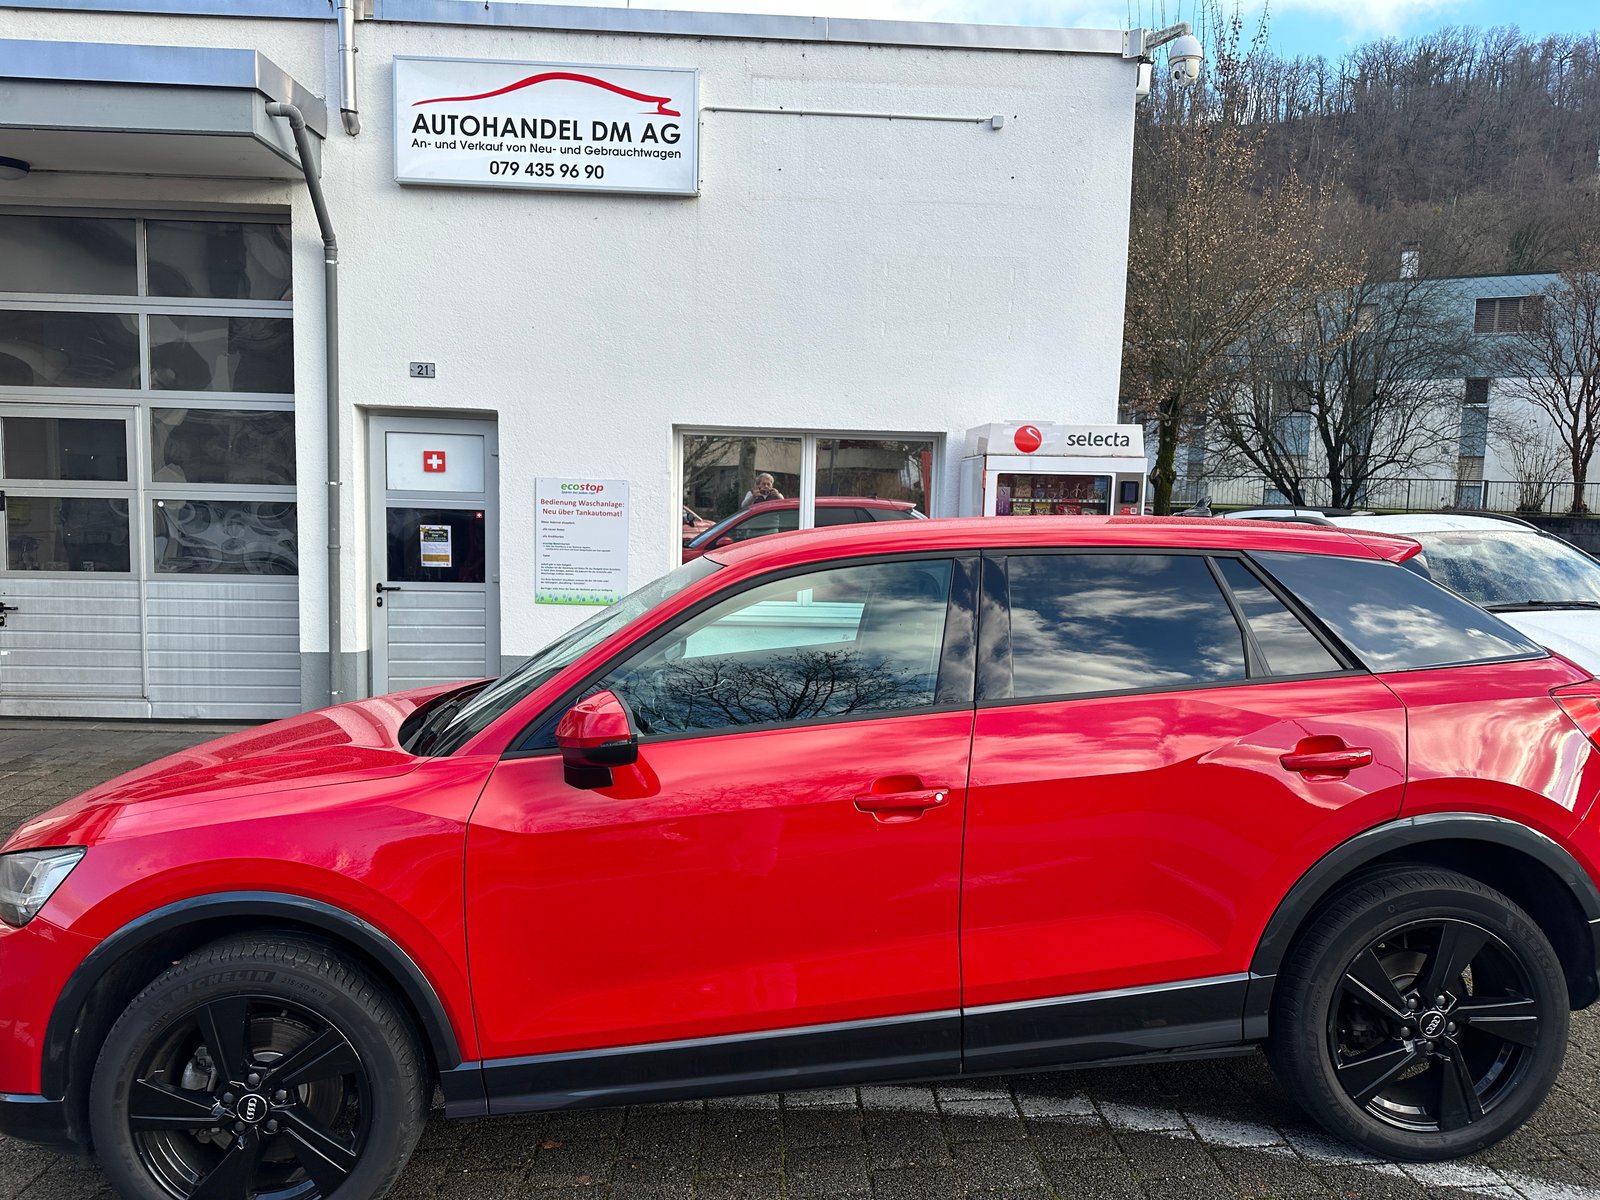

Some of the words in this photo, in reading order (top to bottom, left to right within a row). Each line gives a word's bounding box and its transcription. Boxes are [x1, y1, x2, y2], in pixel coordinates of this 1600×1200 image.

[412, 113, 583, 141] AUTOHANDEL
[592, 121, 633, 143] DM
[640, 123, 681, 145] AG
[411, 138, 431, 149] An-
[435, 140, 457, 150] und
[460, 140, 504, 152] Verkauf
[506, 144, 527, 153] von
[530, 143, 557, 154] Neu-
[560, 145, 581, 155] und
[584, 145, 682, 161] Gebrauchtwagen
[490, 161, 520, 176] 079
[525, 162, 555, 178] 435
[560, 163, 580, 178] 96
[584, 164, 605, 180] 90
[417, 364, 429, 375] 21
[1066, 432, 1130, 447] selecta
[561, 483, 604, 493] ecostop
[540, 498, 577, 507] Bedienung
[578, 500, 625, 509] Waschanlage:
[558, 508, 574, 516] über
[576, 509, 623, 518] Tankautomat!
